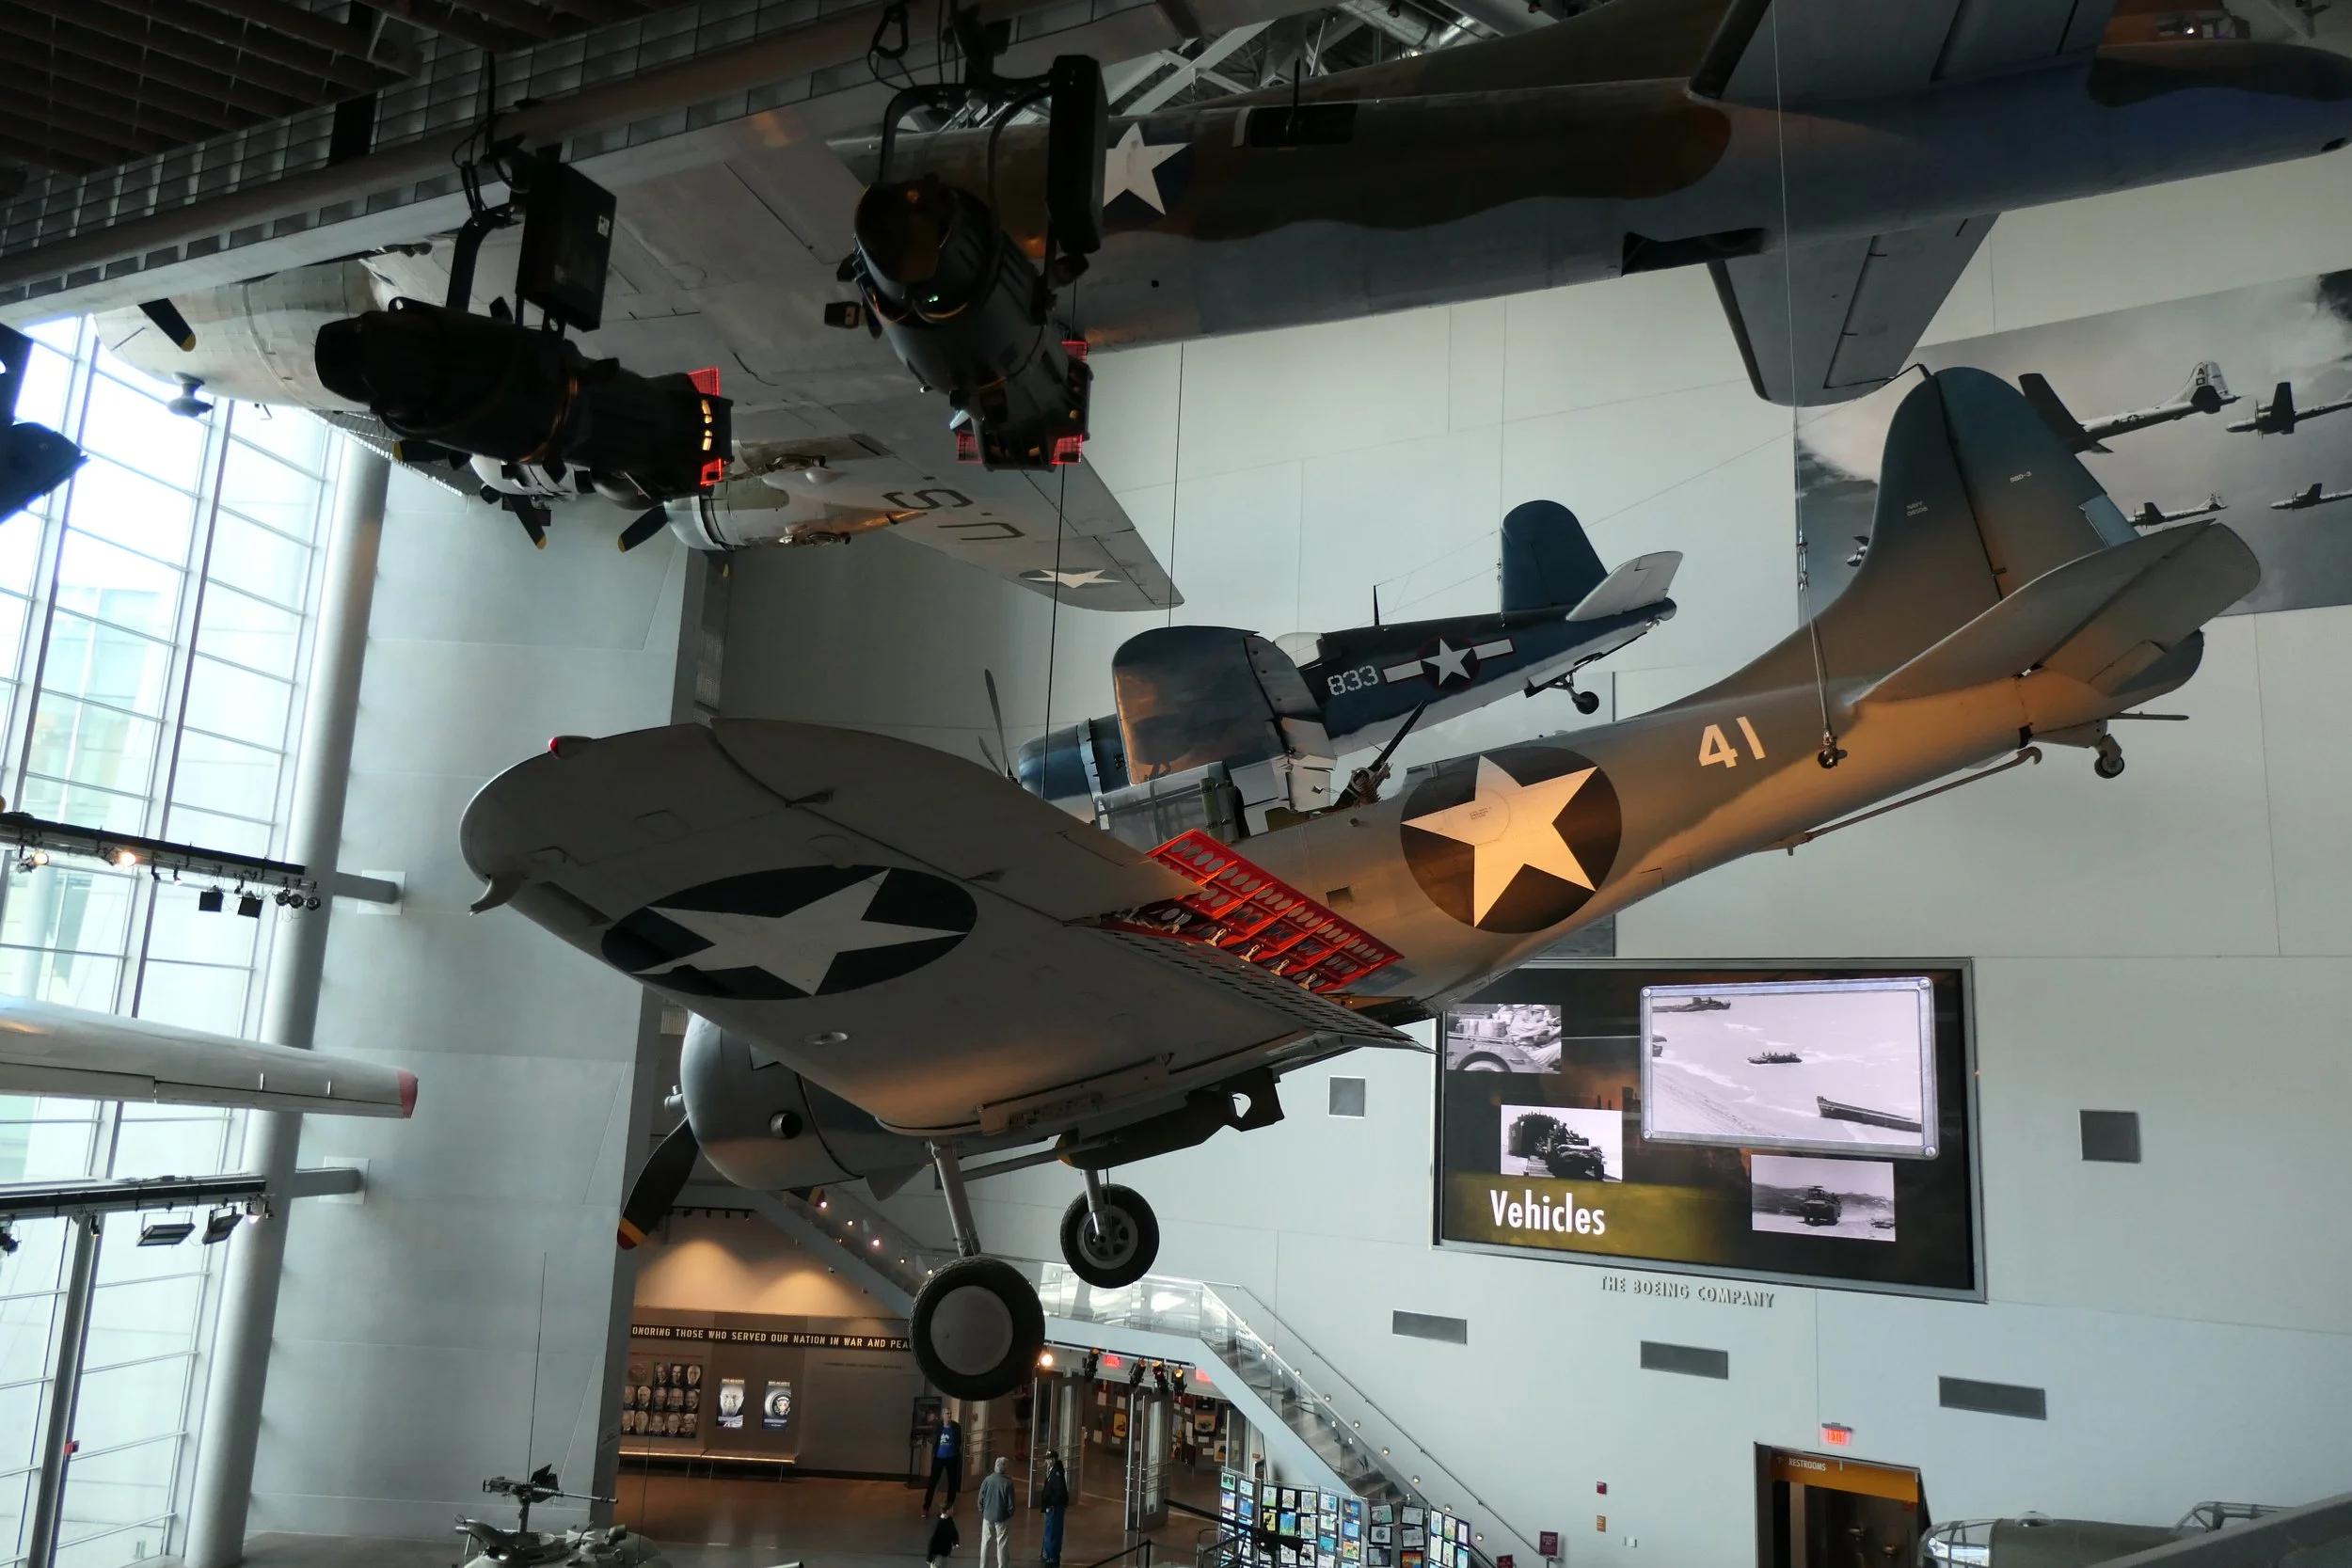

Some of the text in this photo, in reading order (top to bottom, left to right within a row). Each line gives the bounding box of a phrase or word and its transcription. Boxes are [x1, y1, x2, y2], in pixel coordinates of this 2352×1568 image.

[2010, 471, 2032, 483] SBD-3
[1327, 664, 1379, 696] 833
[1697, 715, 1767, 768] 41
[1489, 1188, 1607, 1236] Vehicles
[1601, 1275, 1775, 1308] THE BOEING COMPANY
[631, 1326, 909, 1349] ONORING THOSE WHO SERVED OUR NATION IN WAR AND PEA
[1827, 1429, 1846, 1445] EXIT
[1788, 1457, 1827, 1472] RESTROOMS
